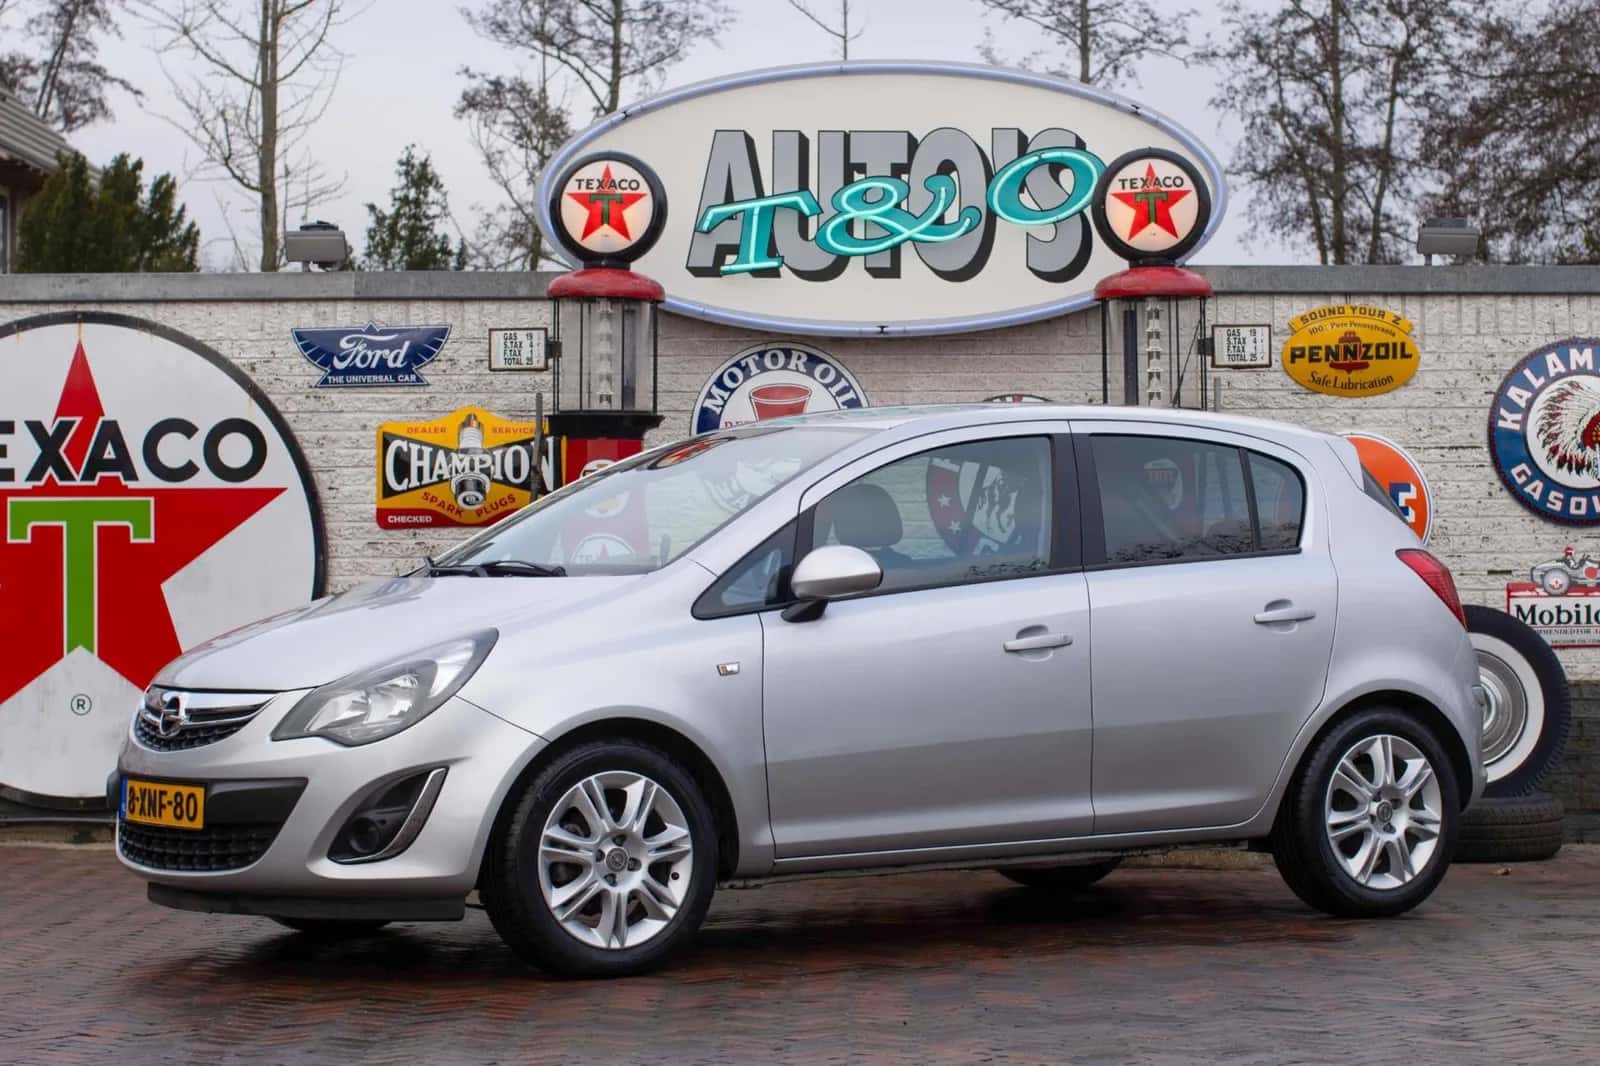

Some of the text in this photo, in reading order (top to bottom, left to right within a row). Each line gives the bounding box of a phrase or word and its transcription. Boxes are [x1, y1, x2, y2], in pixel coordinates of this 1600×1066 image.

[575, 178, 641, 192] TEXACO
[1118, 175, 1185, 190] TEXACO
[686, 127, 1092, 283] AUTO'S
[1300, 306, 1346, 325] SOUND
[1350, 306, 1387, 319] YOUR
[333, 333, 411, 370] Ford
[503, 357, 523, 365] TOTAL
[1226, 353, 1248, 361] TOTAL
[1290, 342, 1413, 364] PENNZOIL
[328, 374, 417, 385] THE UNIVERSAL CAR
[702, 350, 857, 415] MOTOR OIL
[1310, 370, 1395, 390] Safe Lubrication
[1498, 348, 1600, 431] KALAM
[407, 426, 447, 434] DEALER
[385, 436, 555, 492] CHAMPION
[1510, 463, 1600, 516] GASO
[421, 491, 517, 518] SPARK PLUGS
[387, 515, 433, 524] CHECKED
[128, 786, 198, 823] 8-XNF-80
